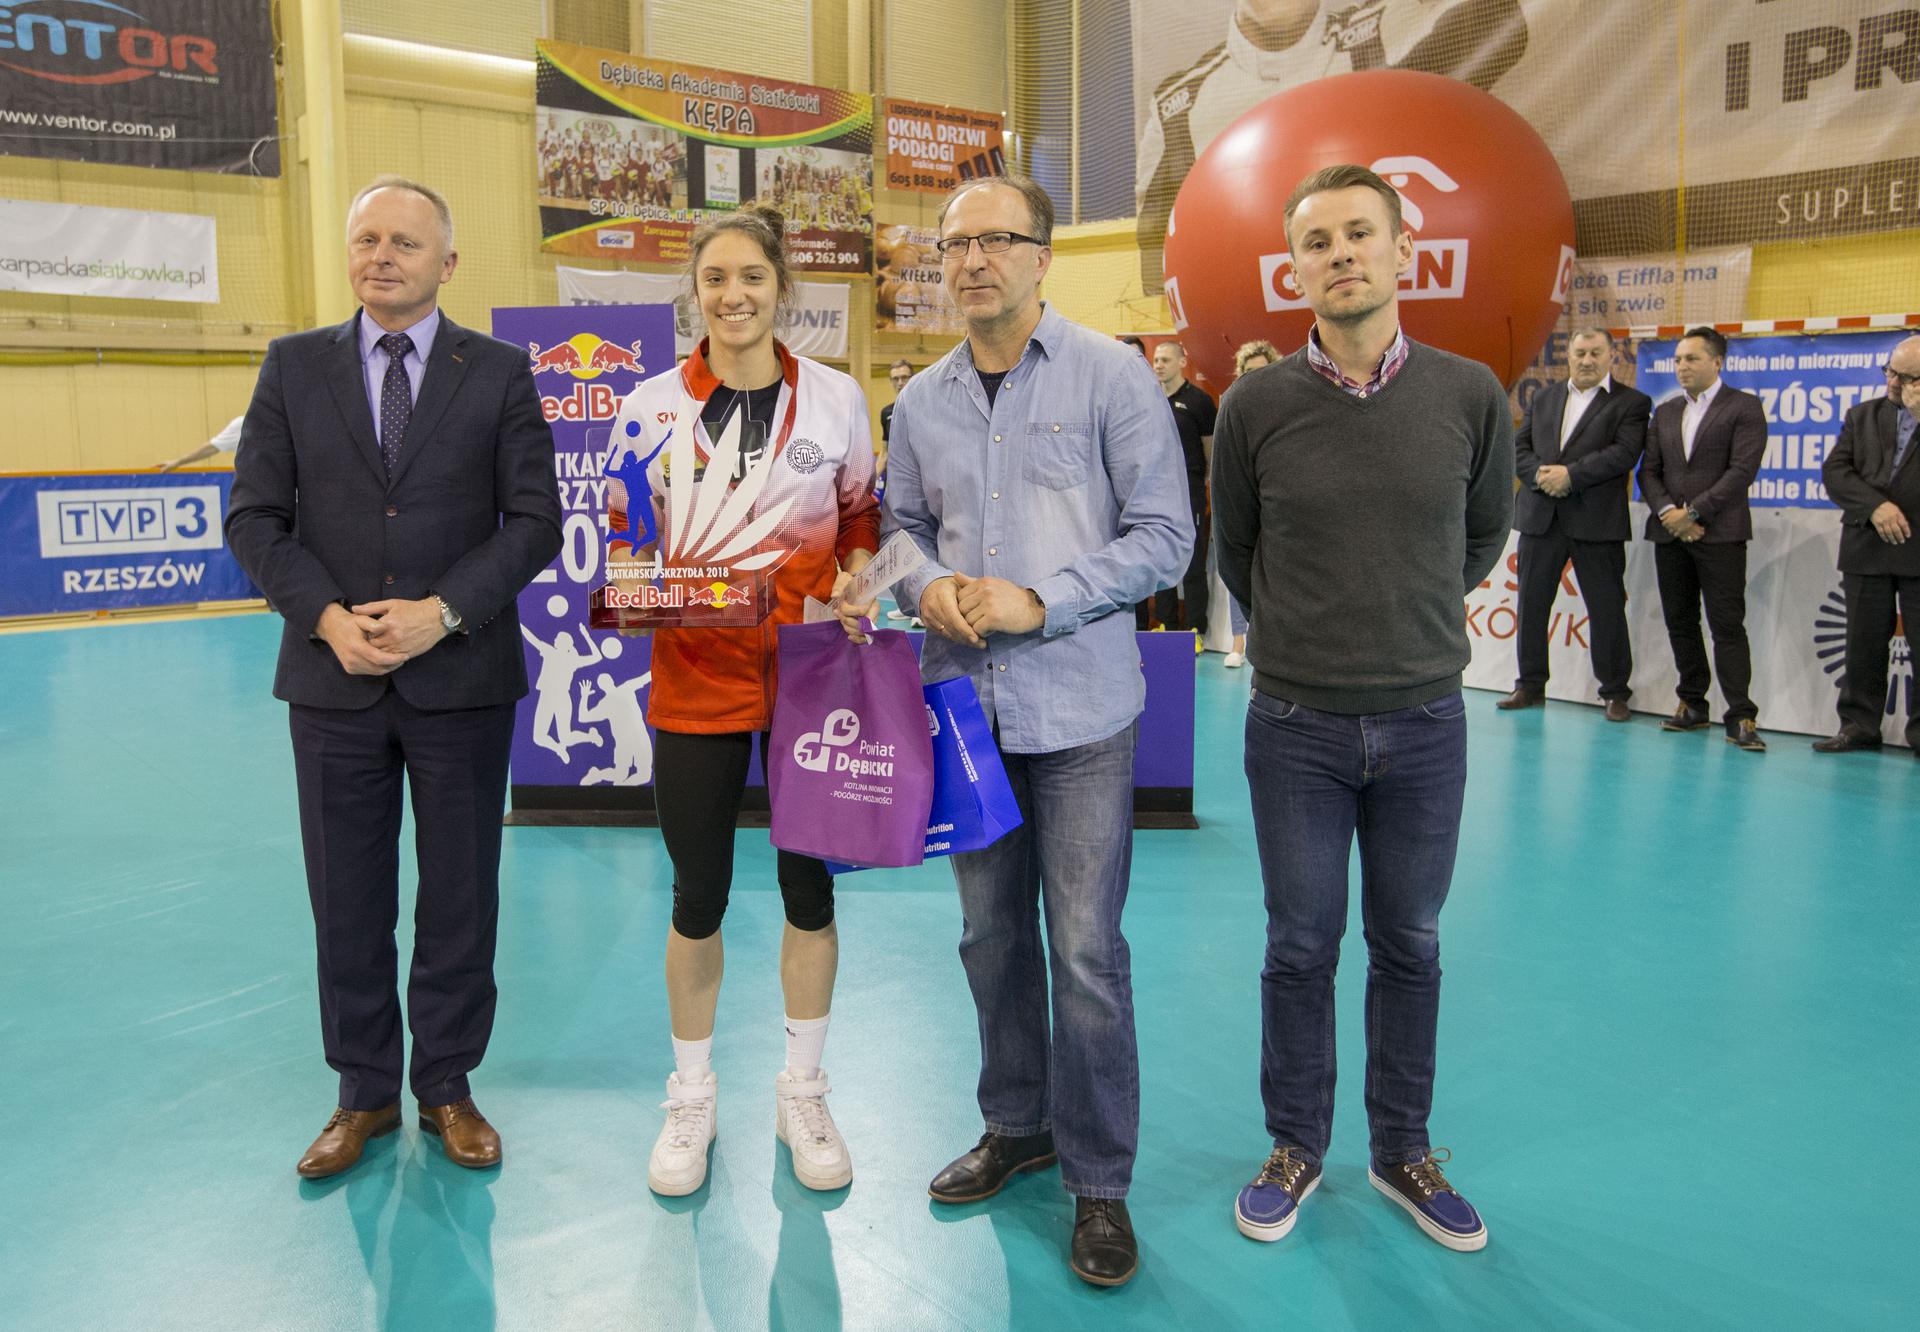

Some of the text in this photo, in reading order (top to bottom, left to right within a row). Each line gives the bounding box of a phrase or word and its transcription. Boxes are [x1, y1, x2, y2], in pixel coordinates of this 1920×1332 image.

[1725, 9, 1920, 113] I PR
[600, 61, 821, 115] Dębicka Akademia Siatkówki
[684, 99, 756, 134] KĘPA
[887, 117, 987, 147] OKNA DRZWI
[887, 136, 954, 162] PODŁOGI
[890, 172, 911, 187] 605
[914, 174, 934, 188] 888
[590, 199, 608, 215] SP
[815, 252, 835, 264] 262
[837, 252, 860, 265] 904
[1617, 266, 1675, 287] Eiffla
[1683, 266, 1718, 282] ma
[1579, 297, 1609, 318] się
[1615, 293, 1666, 313] zwie
[1726, 355, 1767, 372] Ciebie
[1770, 354, 1795, 371] nie
[1798, 353, 1874, 370] mierzymy
[1875, 353, 1889, 367] w
[65, 496, 209, 540] TVP 3
[63, 558, 206, 594] RZESZÓW
[660, 567, 703, 579] SKRZYDŁA
[706, 566, 729, 578] 2018
[859, 740, 896, 758] Powiat
[833, 790, 863, 802] POGÓRZE
[843, 782, 867, 791] KOTLINA
